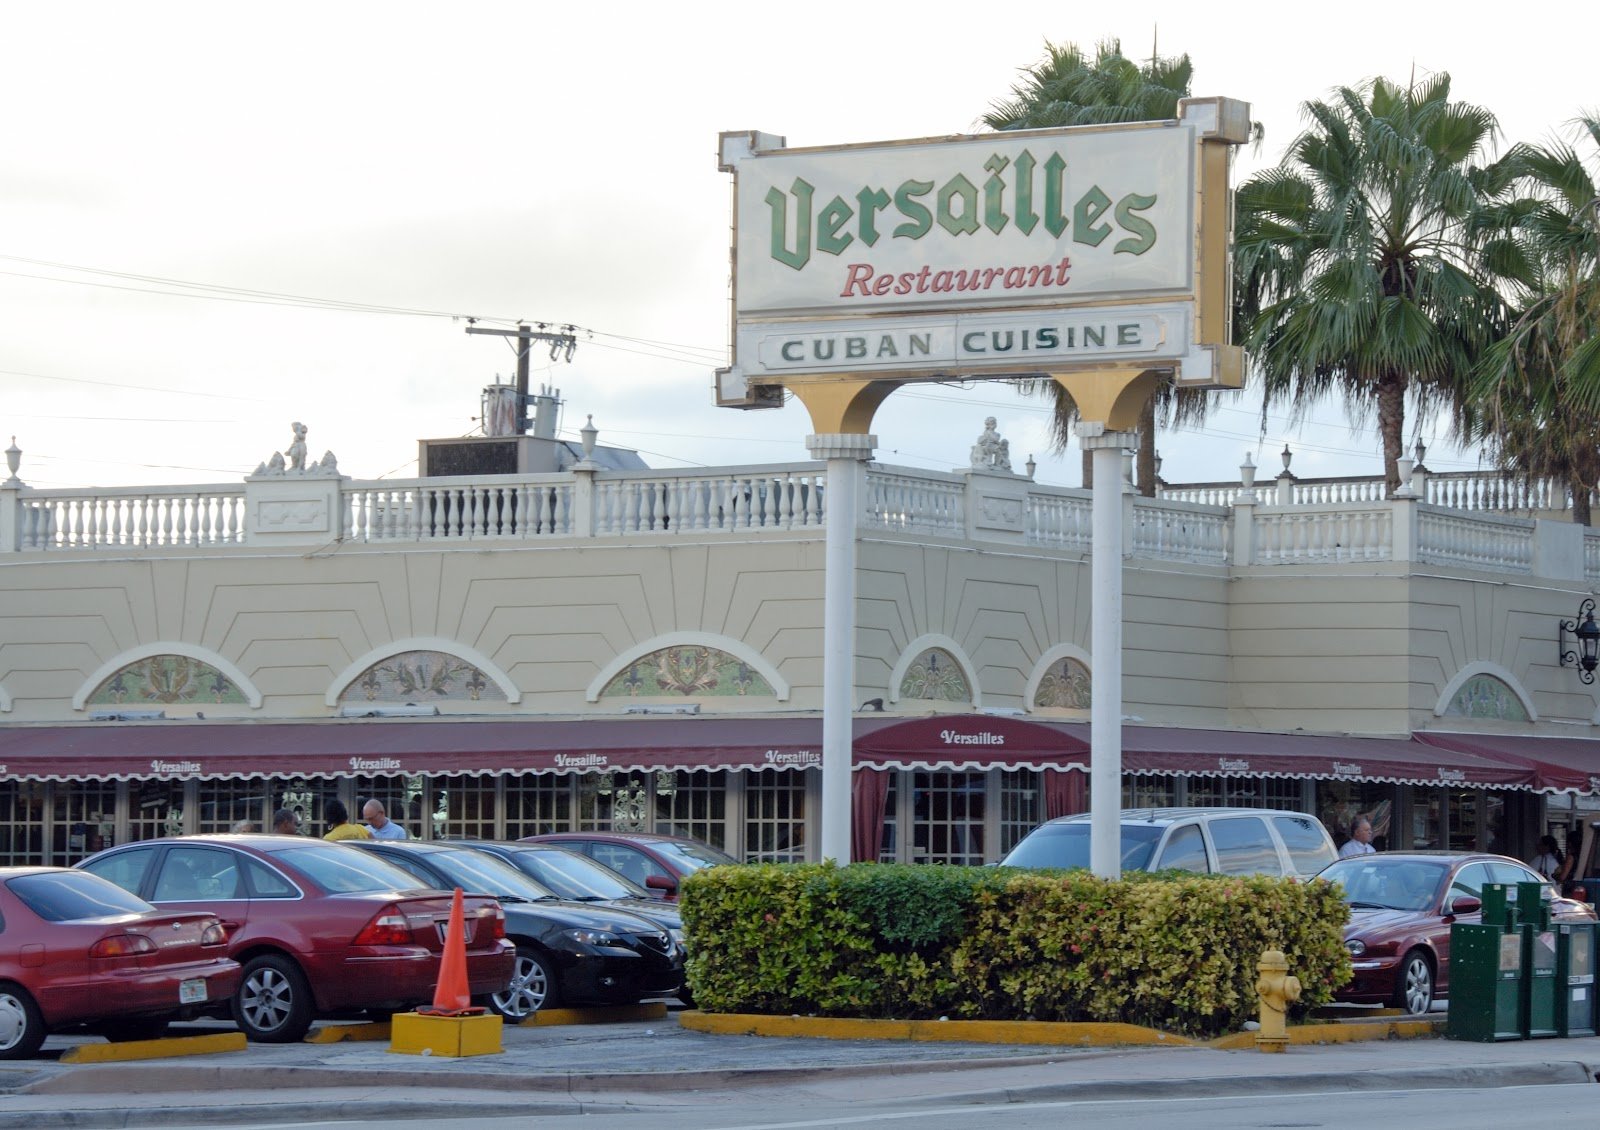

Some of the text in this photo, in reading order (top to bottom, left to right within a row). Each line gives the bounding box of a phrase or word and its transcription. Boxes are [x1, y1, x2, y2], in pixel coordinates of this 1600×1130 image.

[763, 148, 1158, 271] Versailles
[840, 257, 1072, 298] Restaurant
[781, 323, 1143, 361] CUBAN CUISINE
[940, 729, 1005, 746] Versailles
[349, 756, 401, 770] Versailles
[554, 753, 608, 767] Versailles
[765, 750, 821, 764] Versailles
[151, 759, 202, 774] Versailles
